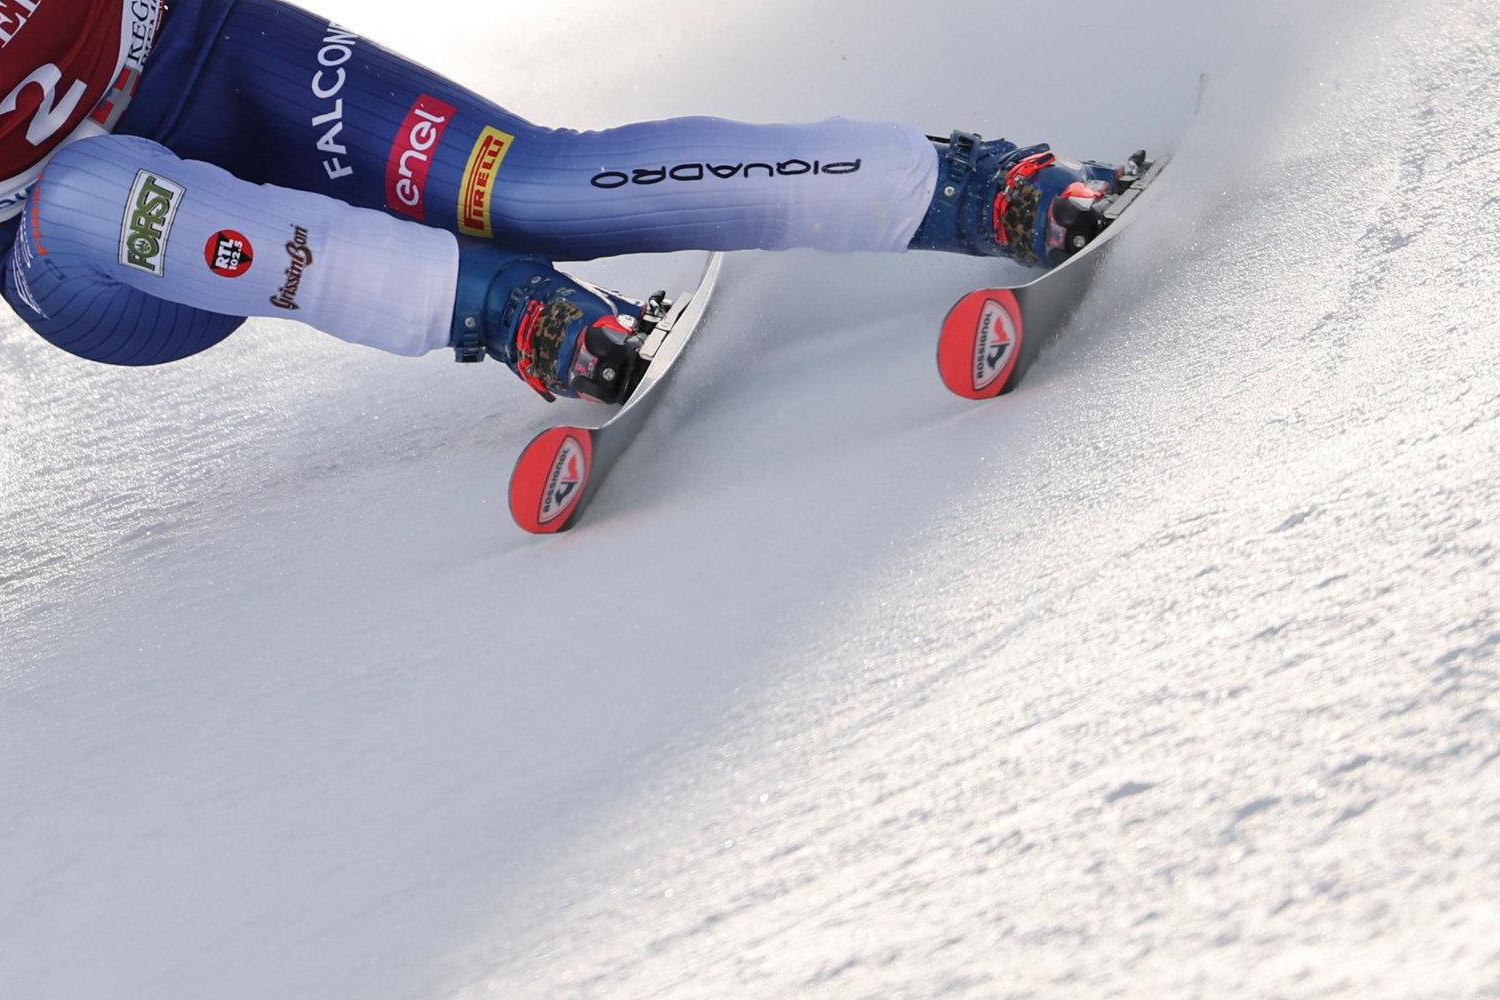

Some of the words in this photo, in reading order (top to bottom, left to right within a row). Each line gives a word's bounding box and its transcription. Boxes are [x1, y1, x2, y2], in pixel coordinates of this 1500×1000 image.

[311, 21, 359, 180] FALCON
[395, 108, 445, 206] enel
[463, 135, 505, 231] PIRELLI
[590, 158, 862, 189] PIQUADRO
[127, 176, 175, 272] FORST
[214, 239, 235, 270] RTL
[229, 240, 244, 271] 102.5
